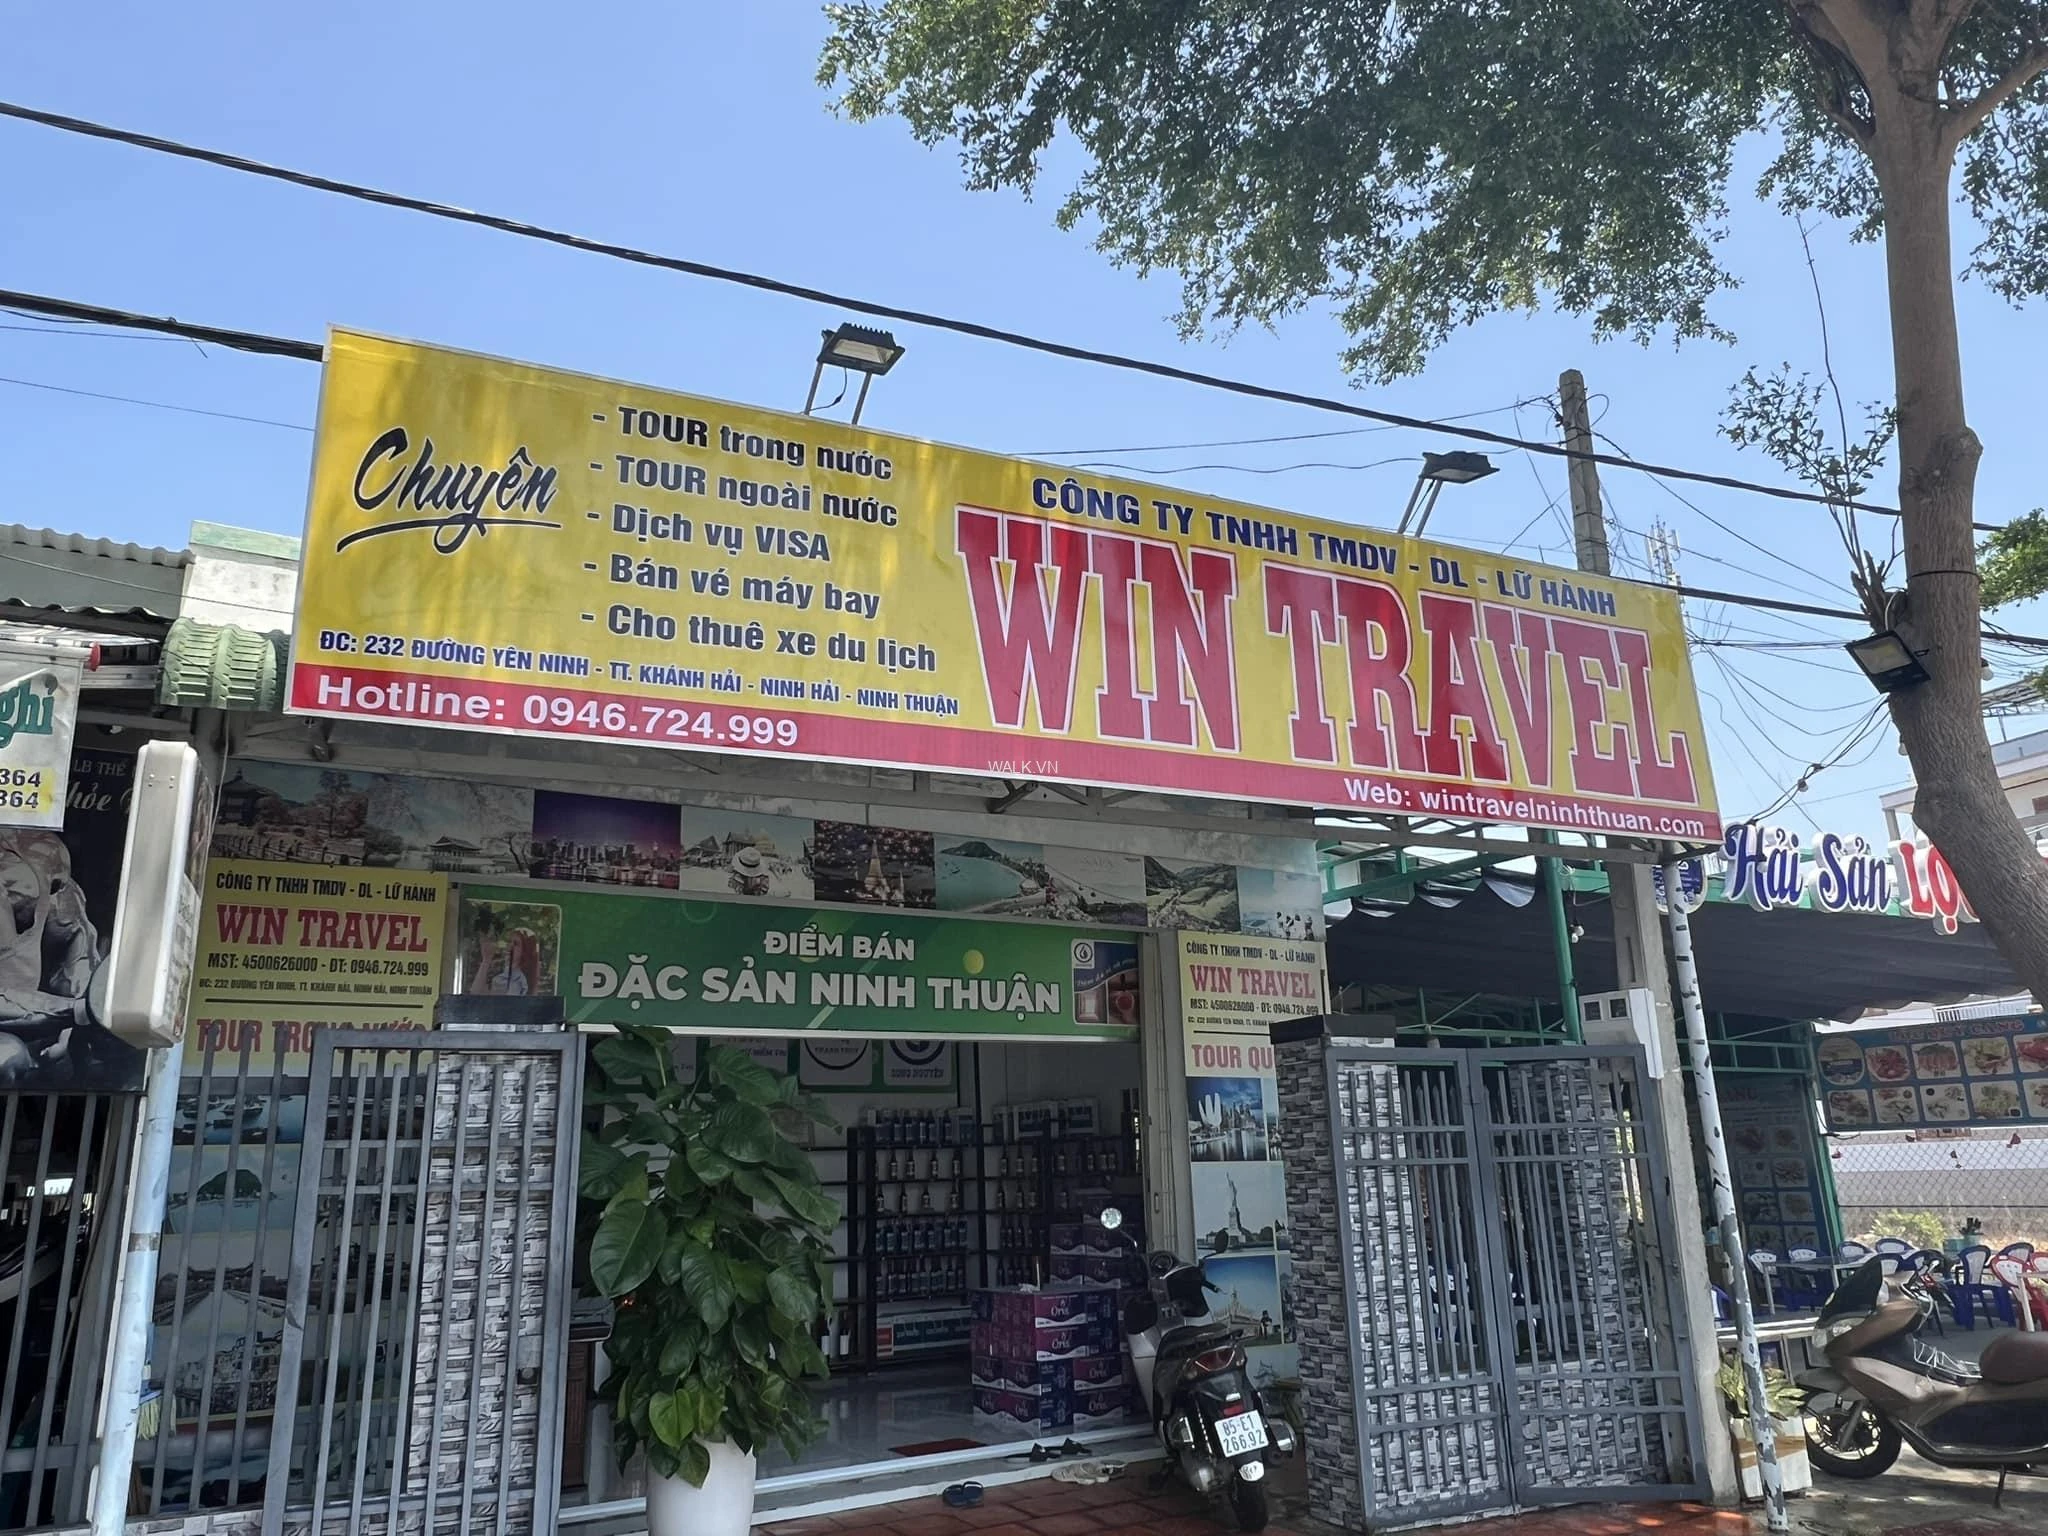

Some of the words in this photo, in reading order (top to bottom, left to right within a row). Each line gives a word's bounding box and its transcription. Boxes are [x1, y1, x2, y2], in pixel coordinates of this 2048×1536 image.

[618, 406, 708, 448] TOUR
[720, 426, 805, 466] trong
[817, 445, 892, 481] nước
[353, 427, 558, 555] Chuyên
[615, 455, 706, 495] TOUR
[718, 473, 811, 511] ngoài
[822, 492, 898, 527] nước
[612, 504, 692, 543] Dịch
[705, 523, 743, 555] vụ
[756, 526, 831, 562] VISA
[1032, 477, 1140, 526] CÔNG
[1152, 500, 1194, 535] TY
[1206, 511, 1298, 556] TNHH
[1308, 532, 1396, 575] TMDV
[1430, 557, 1468, 588] DL
[1497, 570, 1531, 600] LỮ
[1540, 579, 1616, 617] HÀNH
[611, 554, 679, 590] Bán
[690, 568, 730, 596] vé
[742, 576, 813, 610] máy
[824, 583, 880, 620] bay
[607, 604, 676, 640] Cho
[689, 615, 765, 650] thuê
[776, 629, 816, 657] xe
[828, 634, 866, 663] du
[878, 638, 936, 674] lịch
[955, 504, 1241, 754] WIN
[1262, 559, 1700, 806] TRAVEL
[319, 630, 357, 652] ĐC:
[364, 635, 404, 657] 232
[411, 637, 485, 666] ĐƯỜNG
[492, 647, 532, 670] YÊN
[539, 654, 589, 677] NINH
[609, 661, 633, 682] TT.
[639, 664, 705, 690] KHÁNH
[711, 668, 742, 694] HẢI
[760, 678, 805, 699] NINH
[811, 679, 840, 703] HẢI
[857, 688, 900, 710] NINH
[904, 693, 959, 719] THUẬN
[317, 674, 505, 721] Hotline:
[522, 695, 799, 747] 0946.724.999
[65, 780, 113, 812] hỏe
[1343, 777, 1411, 808] Web:
[1419, 790, 1705, 837] wintravelninhthuan.com
[216, 870, 252, 890] CÔNG
[257, 875, 271, 892] TY
[275, 876, 308, 894] TNHH
[313, 879, 347, 897] TMDV
[358, 883, 373, 898] DL
[403, 883, 436, 902] HÀNH
[216, 904, 289, 946] WIN
[297, 908, 429, 953] TRAVEL
[763, 923, 843, 958] ĐIỂM
[853, 930, 915, 961] BÁN
[1210, 944, 1219, 956] TY
[208, 953, 238, 969] MST:
[242, 954, 318, 972] 4500626000
[351, 959, 429, 977] 0946.724.999
[577, 953, 689, 1011] ĐẶC
[701, 956, 796, 1005] SẢN
[810, 972, 916, 1009] NINH
[927, 972, 1060, 1022] THUẬN
[1189, 964, 1232, 994] WIN
[1237, 967, 1316, 1000] TRAVEL
[1191, 1044, 1242, 1069] TOUR
[1223, 1429, 1265, 1454] 266.92
